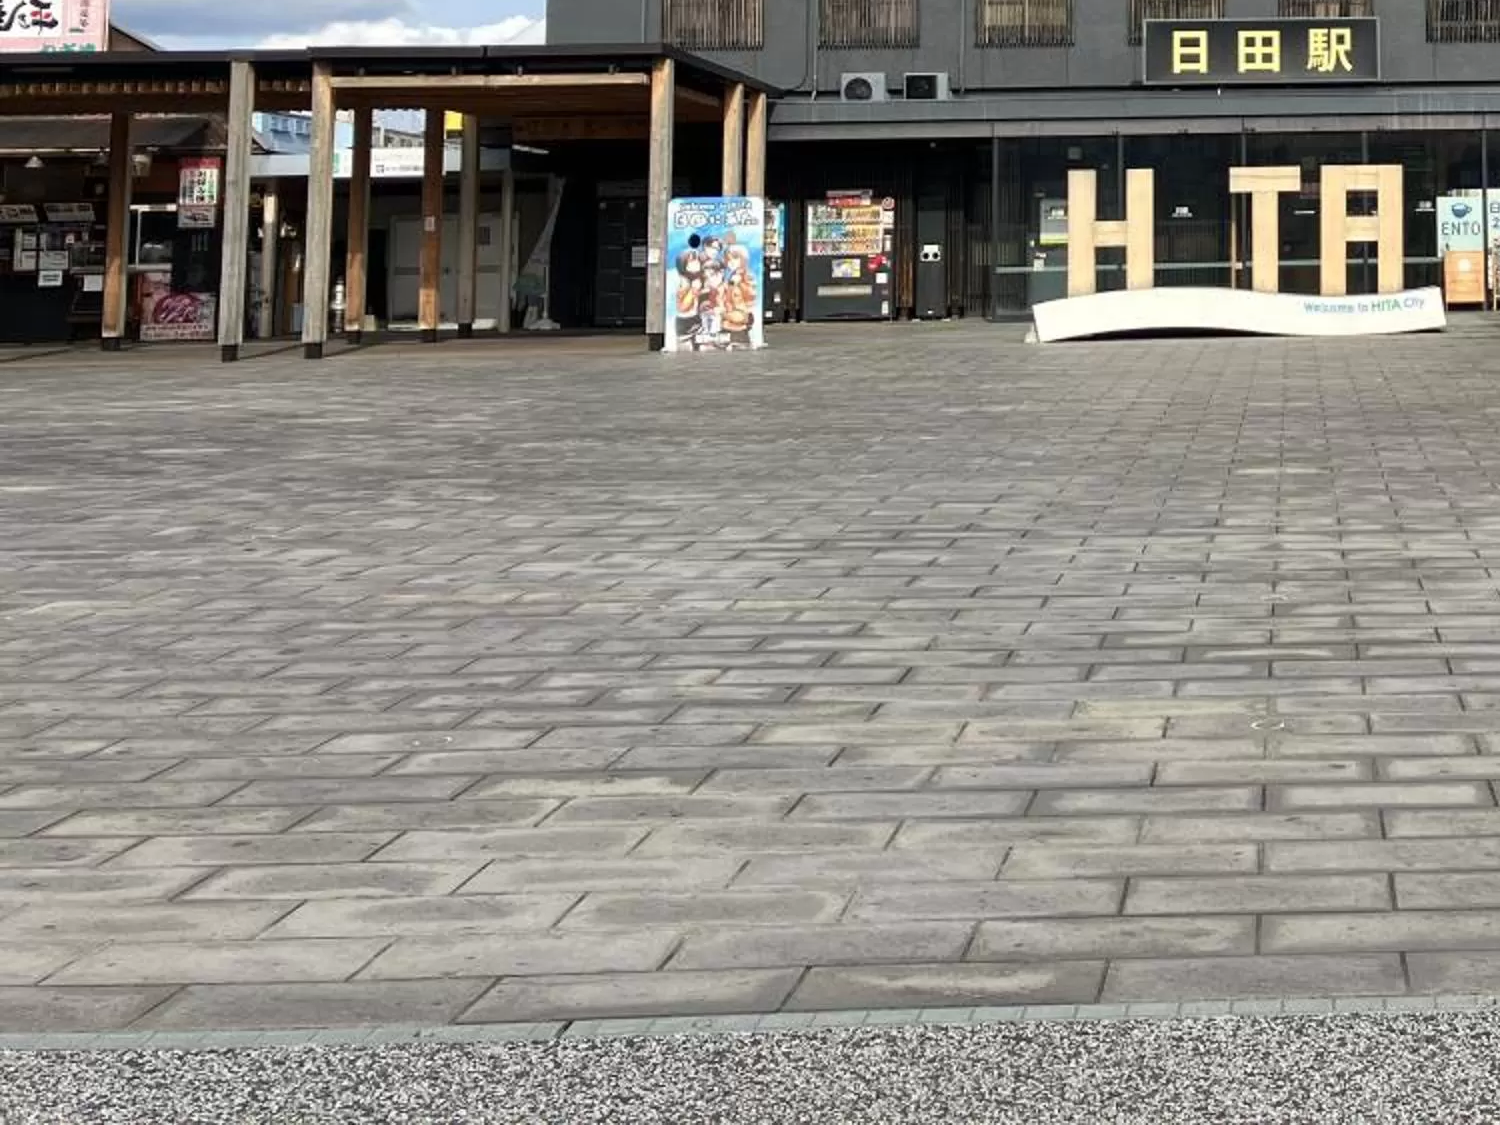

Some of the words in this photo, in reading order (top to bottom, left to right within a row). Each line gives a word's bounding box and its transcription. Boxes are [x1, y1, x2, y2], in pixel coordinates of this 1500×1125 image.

[1172, 28, 1353, 74] 日田駅
[1441, 221, 1481, 236] ENTO
[1371, 298, 1402, 312] HITA
[1403, 296, 1425, 310] City
